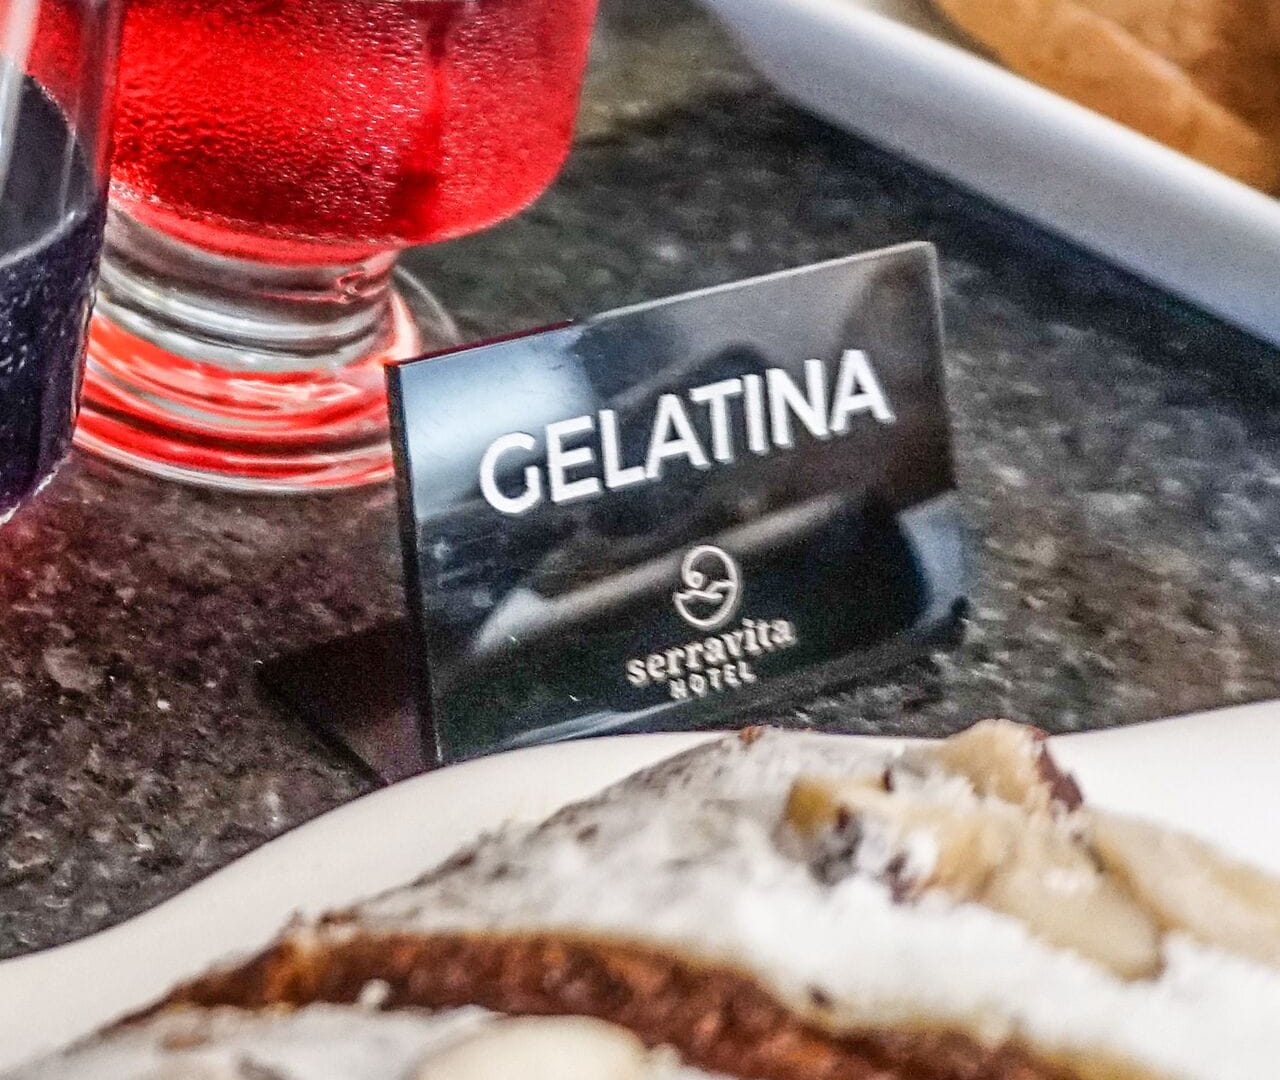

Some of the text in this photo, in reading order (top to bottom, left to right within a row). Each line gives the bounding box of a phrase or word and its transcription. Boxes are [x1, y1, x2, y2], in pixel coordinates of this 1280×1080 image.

[479, 347, 896, 514] GELATINA
[626, 617, 798, 687] serravita
[669, 660, 758, 700] HOTEL
